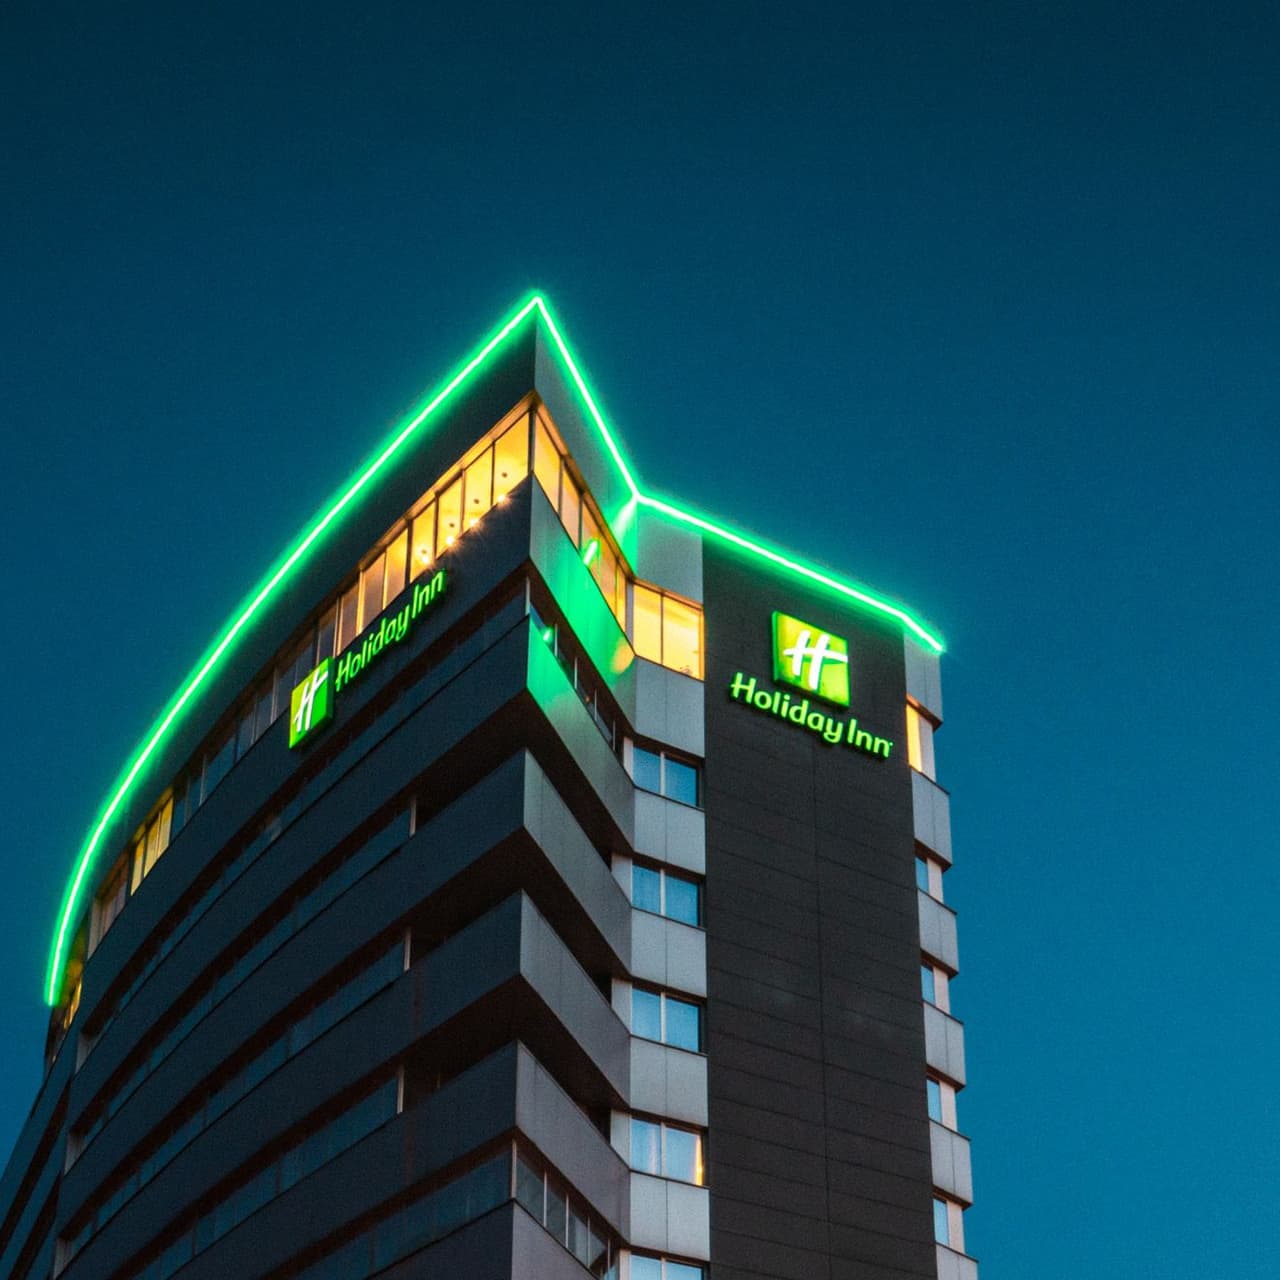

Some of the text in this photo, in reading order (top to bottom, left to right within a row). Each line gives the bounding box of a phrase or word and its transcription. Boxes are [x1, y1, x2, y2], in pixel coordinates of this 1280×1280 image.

[335, 569, 445, 692] Holiday Inn
[730, 671, 891, 758] Holiday Inn
